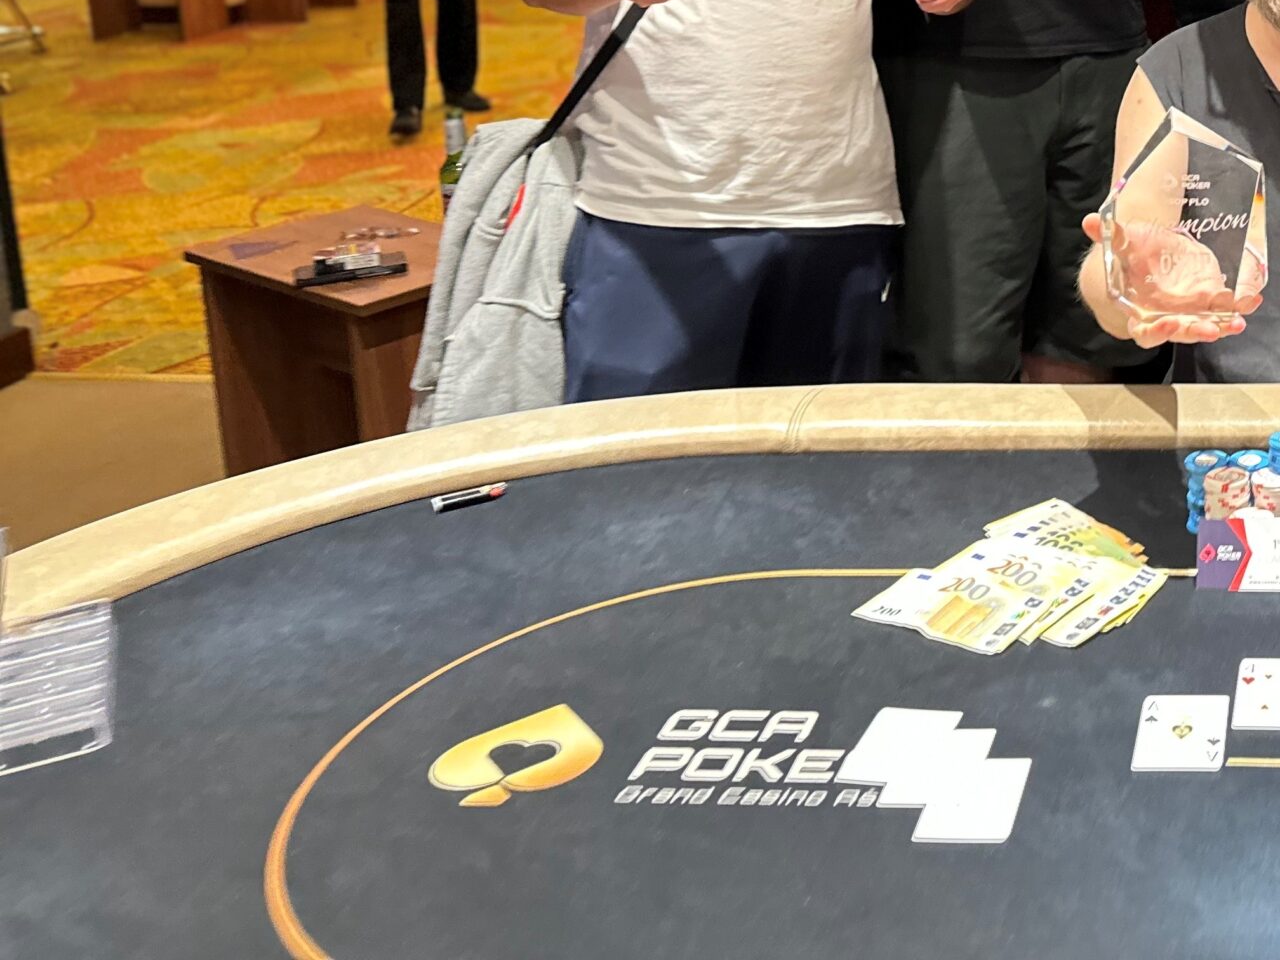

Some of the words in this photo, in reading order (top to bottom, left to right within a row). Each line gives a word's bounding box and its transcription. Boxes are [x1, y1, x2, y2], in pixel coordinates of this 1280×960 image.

[1189, 198, 1210, 206] PLO
[987, 559, 1038, 586] 200
[938, 577, 991, 601] 200
[872, 605, 902, 616] 200
[656, 709, 820, 742] GCA
[628, 746, 845, 783] POKE
[614, 785, 715, 804] Grand
[717, 786, 828, 807] Casino
